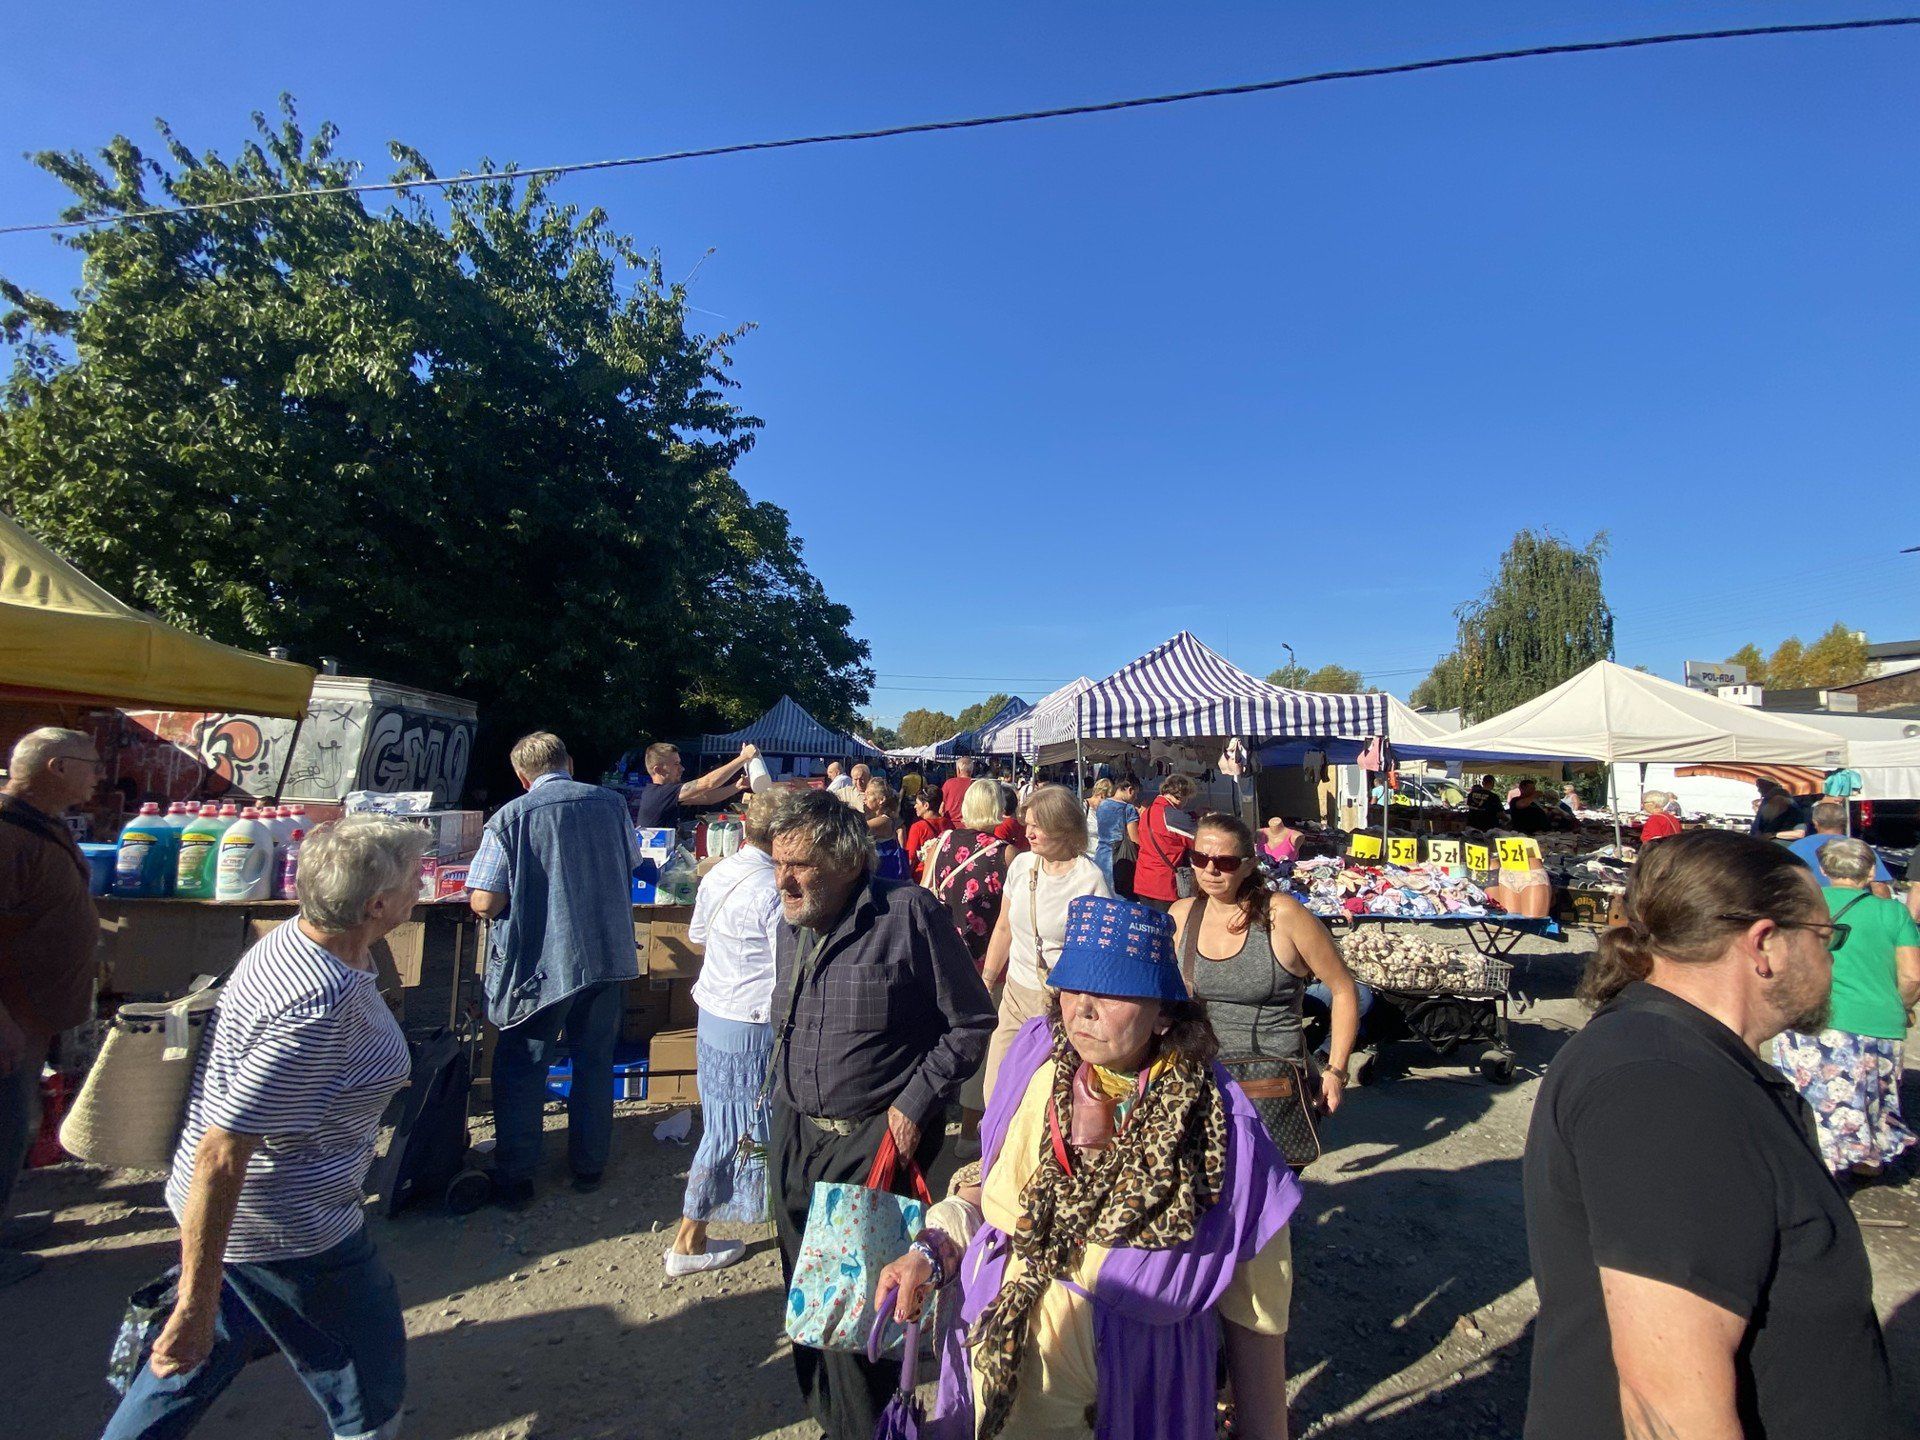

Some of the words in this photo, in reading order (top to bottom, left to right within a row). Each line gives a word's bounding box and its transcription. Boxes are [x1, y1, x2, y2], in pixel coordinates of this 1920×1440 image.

[1391, 840, 1401, 859] 5
[1404, 846, 1415, 860] zł
[1432, 843, 1442, 862] 5
[1445, 850, 1458, 863] zł
[1467, 846, 1473, 865] 5
[1475, 855, 1486, 869] zł
[1499, 840, 1509, 861] 5
[1512, 845, 1525, 862] zł
[1129, 922, 1167, 936] AUSTRAL
